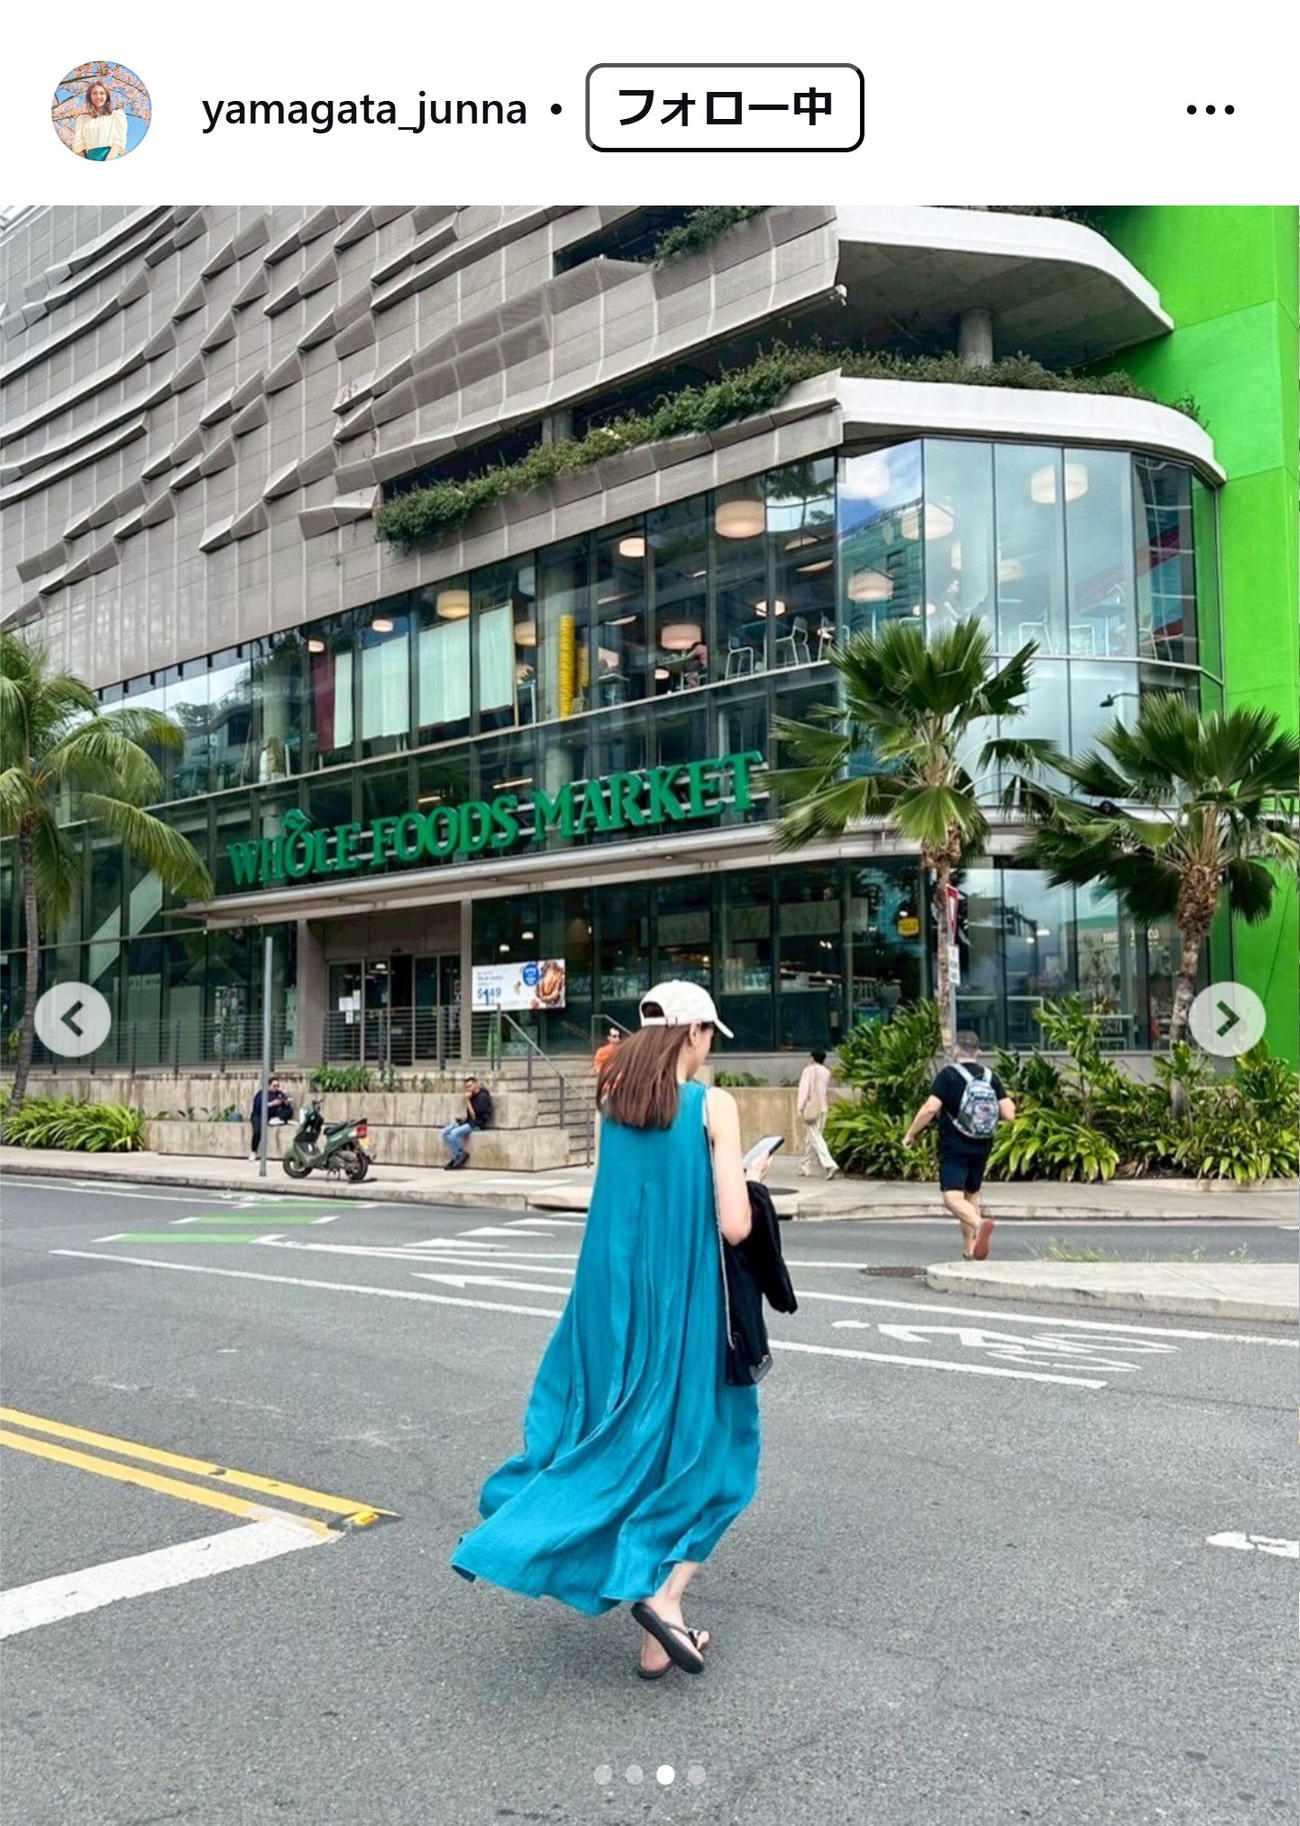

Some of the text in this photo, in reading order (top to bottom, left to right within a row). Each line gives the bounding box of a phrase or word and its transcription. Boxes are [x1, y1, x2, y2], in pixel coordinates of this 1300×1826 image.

[227, 751, 763, 885] WHOLE FOODS MARKET
